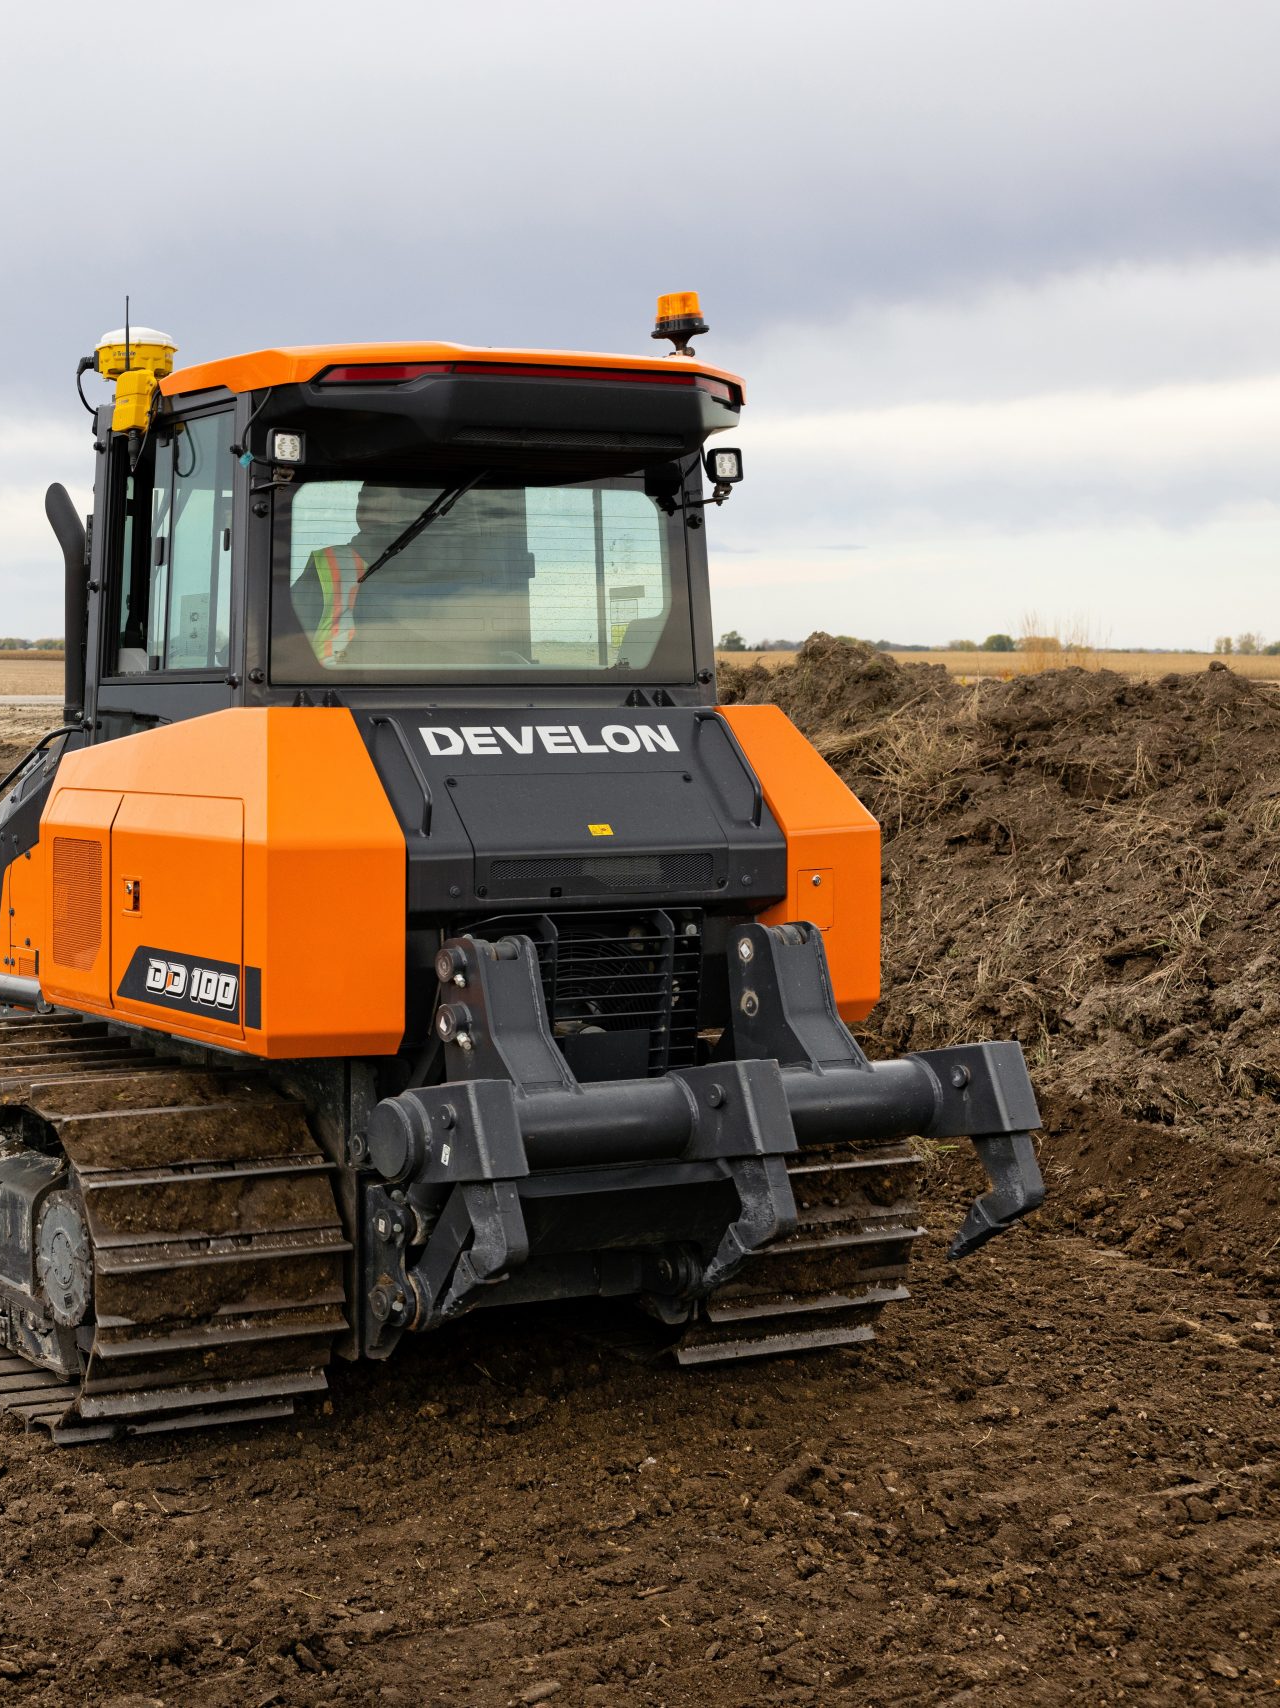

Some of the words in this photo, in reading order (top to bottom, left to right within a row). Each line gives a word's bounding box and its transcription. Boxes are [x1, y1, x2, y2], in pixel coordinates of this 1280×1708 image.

[418, 724, 681, 756] DEVELON
[145, 958, 189, 999] DD
[190, 967, 239, 1011] 100
